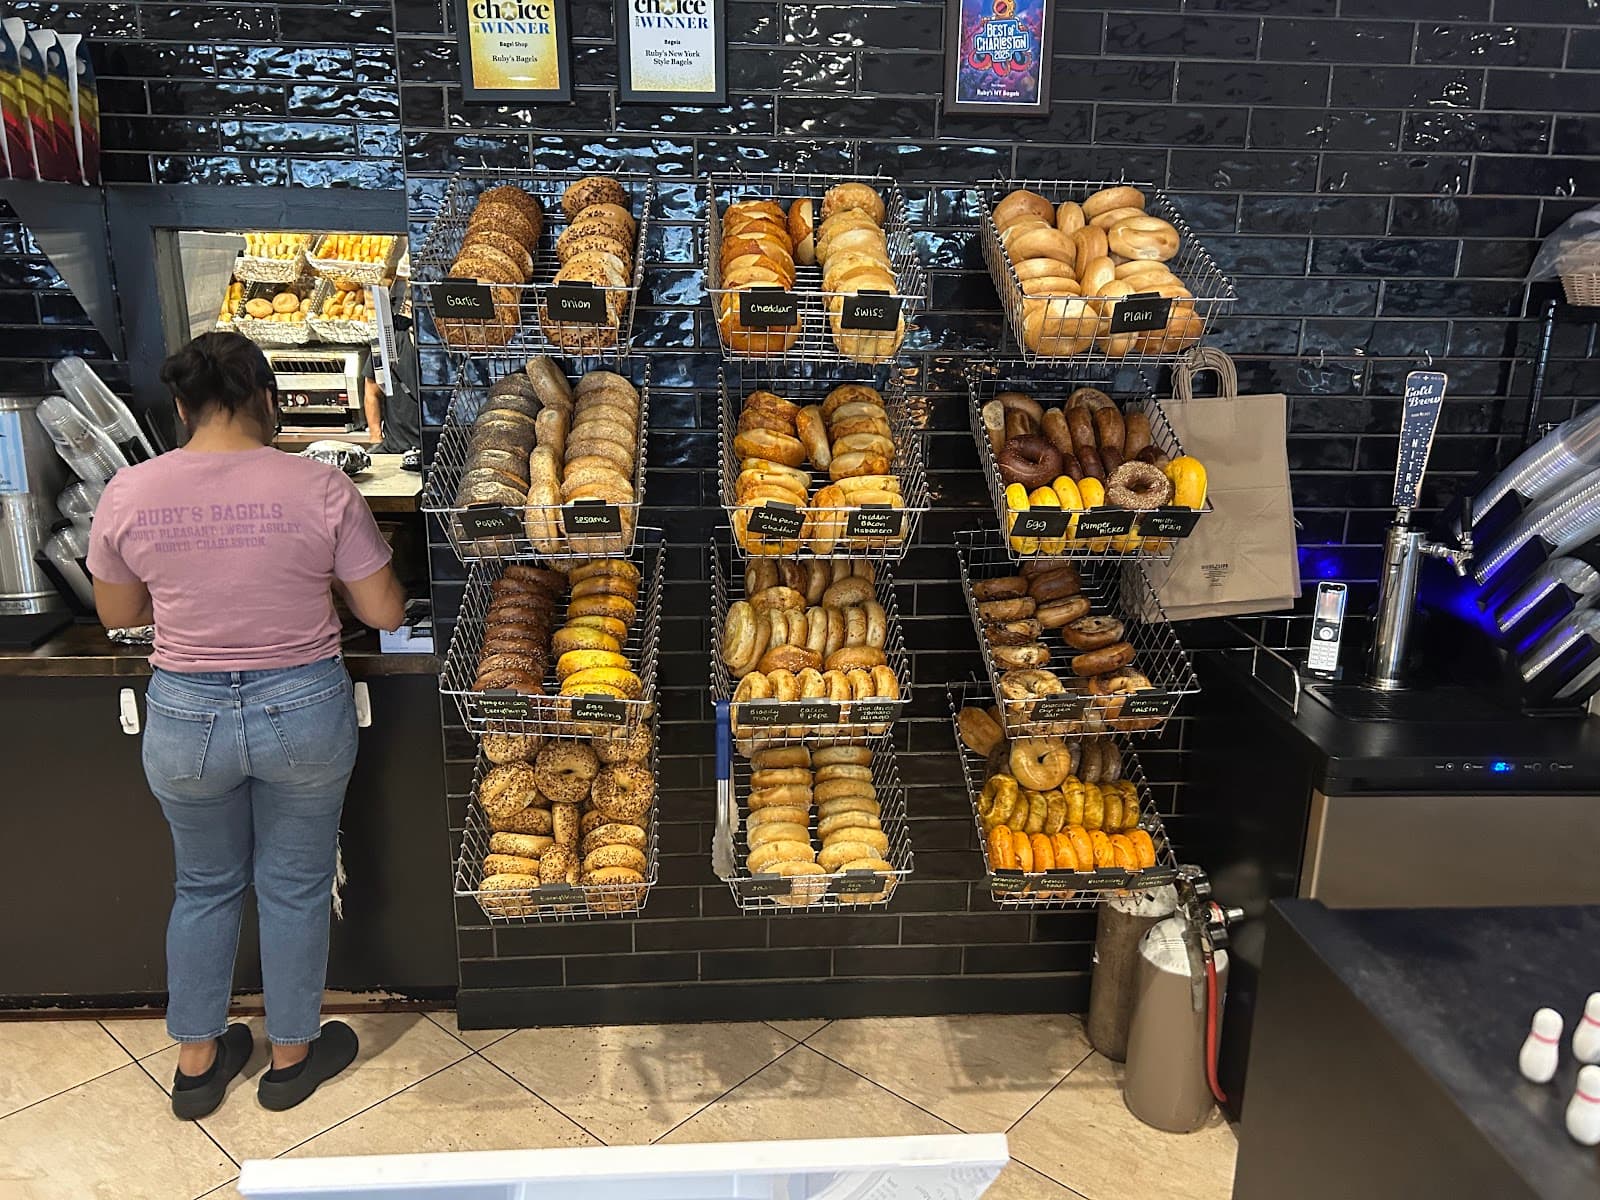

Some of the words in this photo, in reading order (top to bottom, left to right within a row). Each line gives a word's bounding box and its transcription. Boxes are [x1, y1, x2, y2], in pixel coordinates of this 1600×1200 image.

[473, 0, 550, 20] choice
[481, 22, 549, 34] WINNER
[640, 16, 708, 29] WINNER
[986, 24, 1007, 37] BEST
[492, 54, 514, 63] Ruby's
[516, 55, 538, 63] Bagels
[646, 50, 667, 58] Ruby's
[995, 51, 1009, 59] 2025
[653, 58, 670, 66] Style
[671, 58, 692, 66] Bagels
[447, 295, 480, 307] Garlic
[1123, 310, 1153, 322] Plain
[1406, 385, 1433, 398] Cold
[1408, 396, 1441, 407] Brew
[136, 508, 203, 527] RUBY'S
[210, 503, 283, 521] BAGELS
[1025, 519, 1047, 531] Egg
